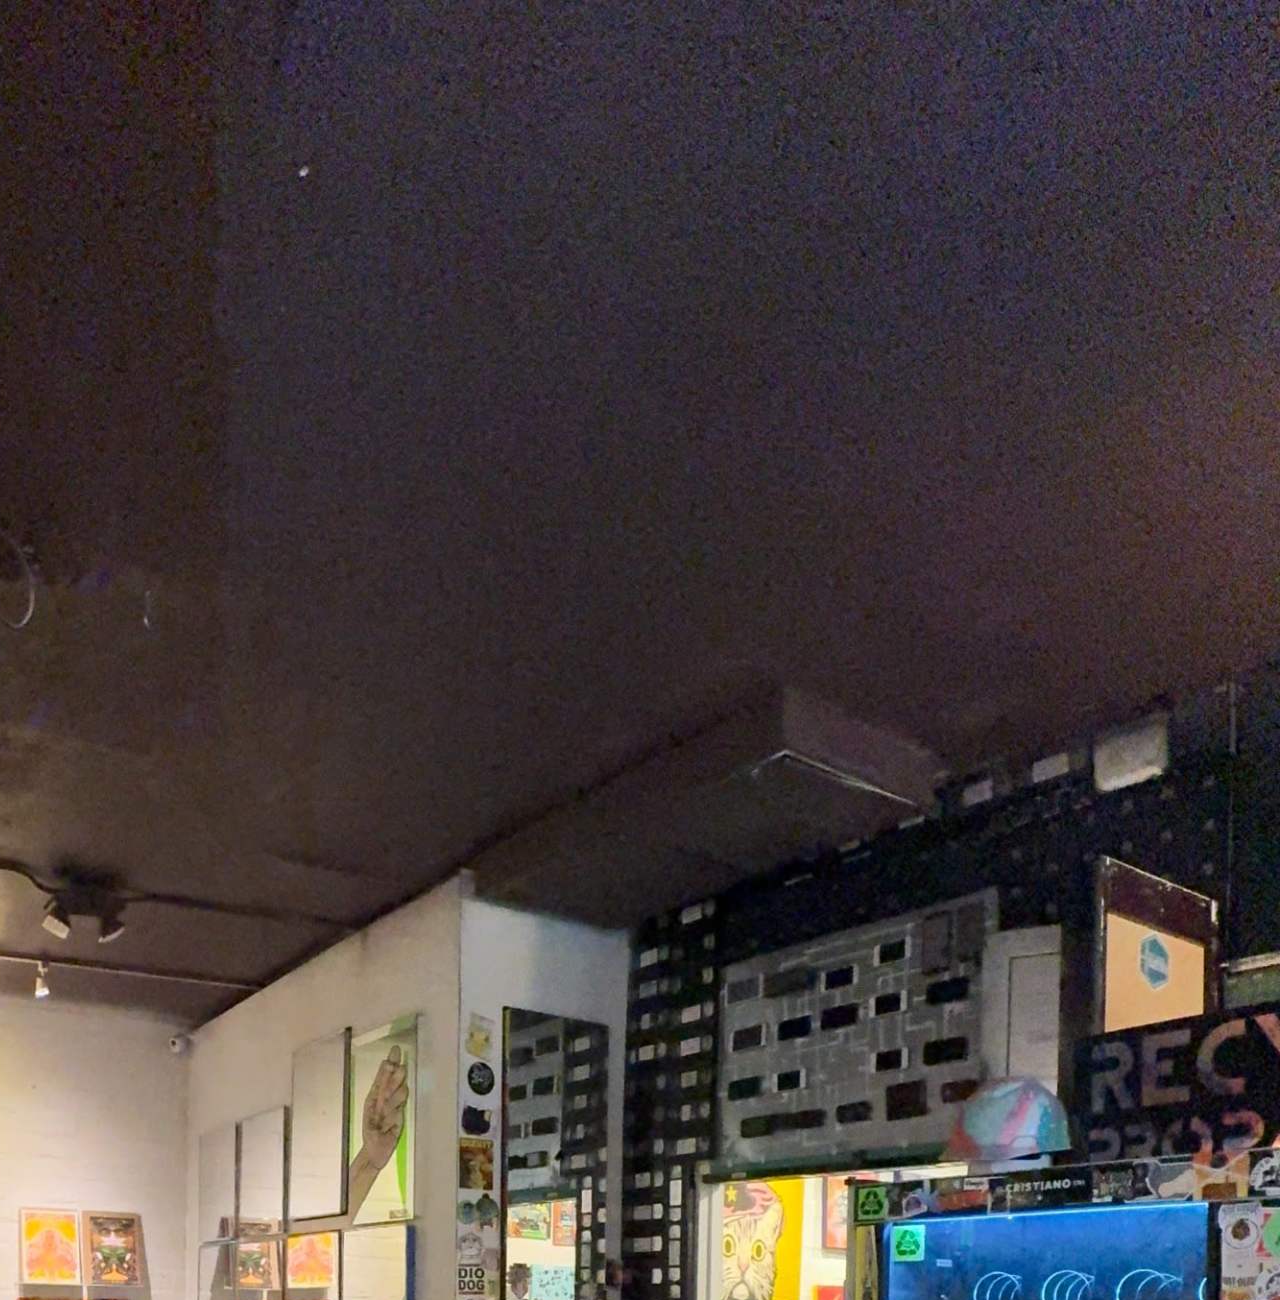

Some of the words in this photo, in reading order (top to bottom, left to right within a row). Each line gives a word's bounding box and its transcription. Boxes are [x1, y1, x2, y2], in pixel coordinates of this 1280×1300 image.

[1006, 1178, 1071, 1193] CRISTIANO
[457, 1267, 485, 1279] DIO
[457, 1279, 485, 1291] DOG
